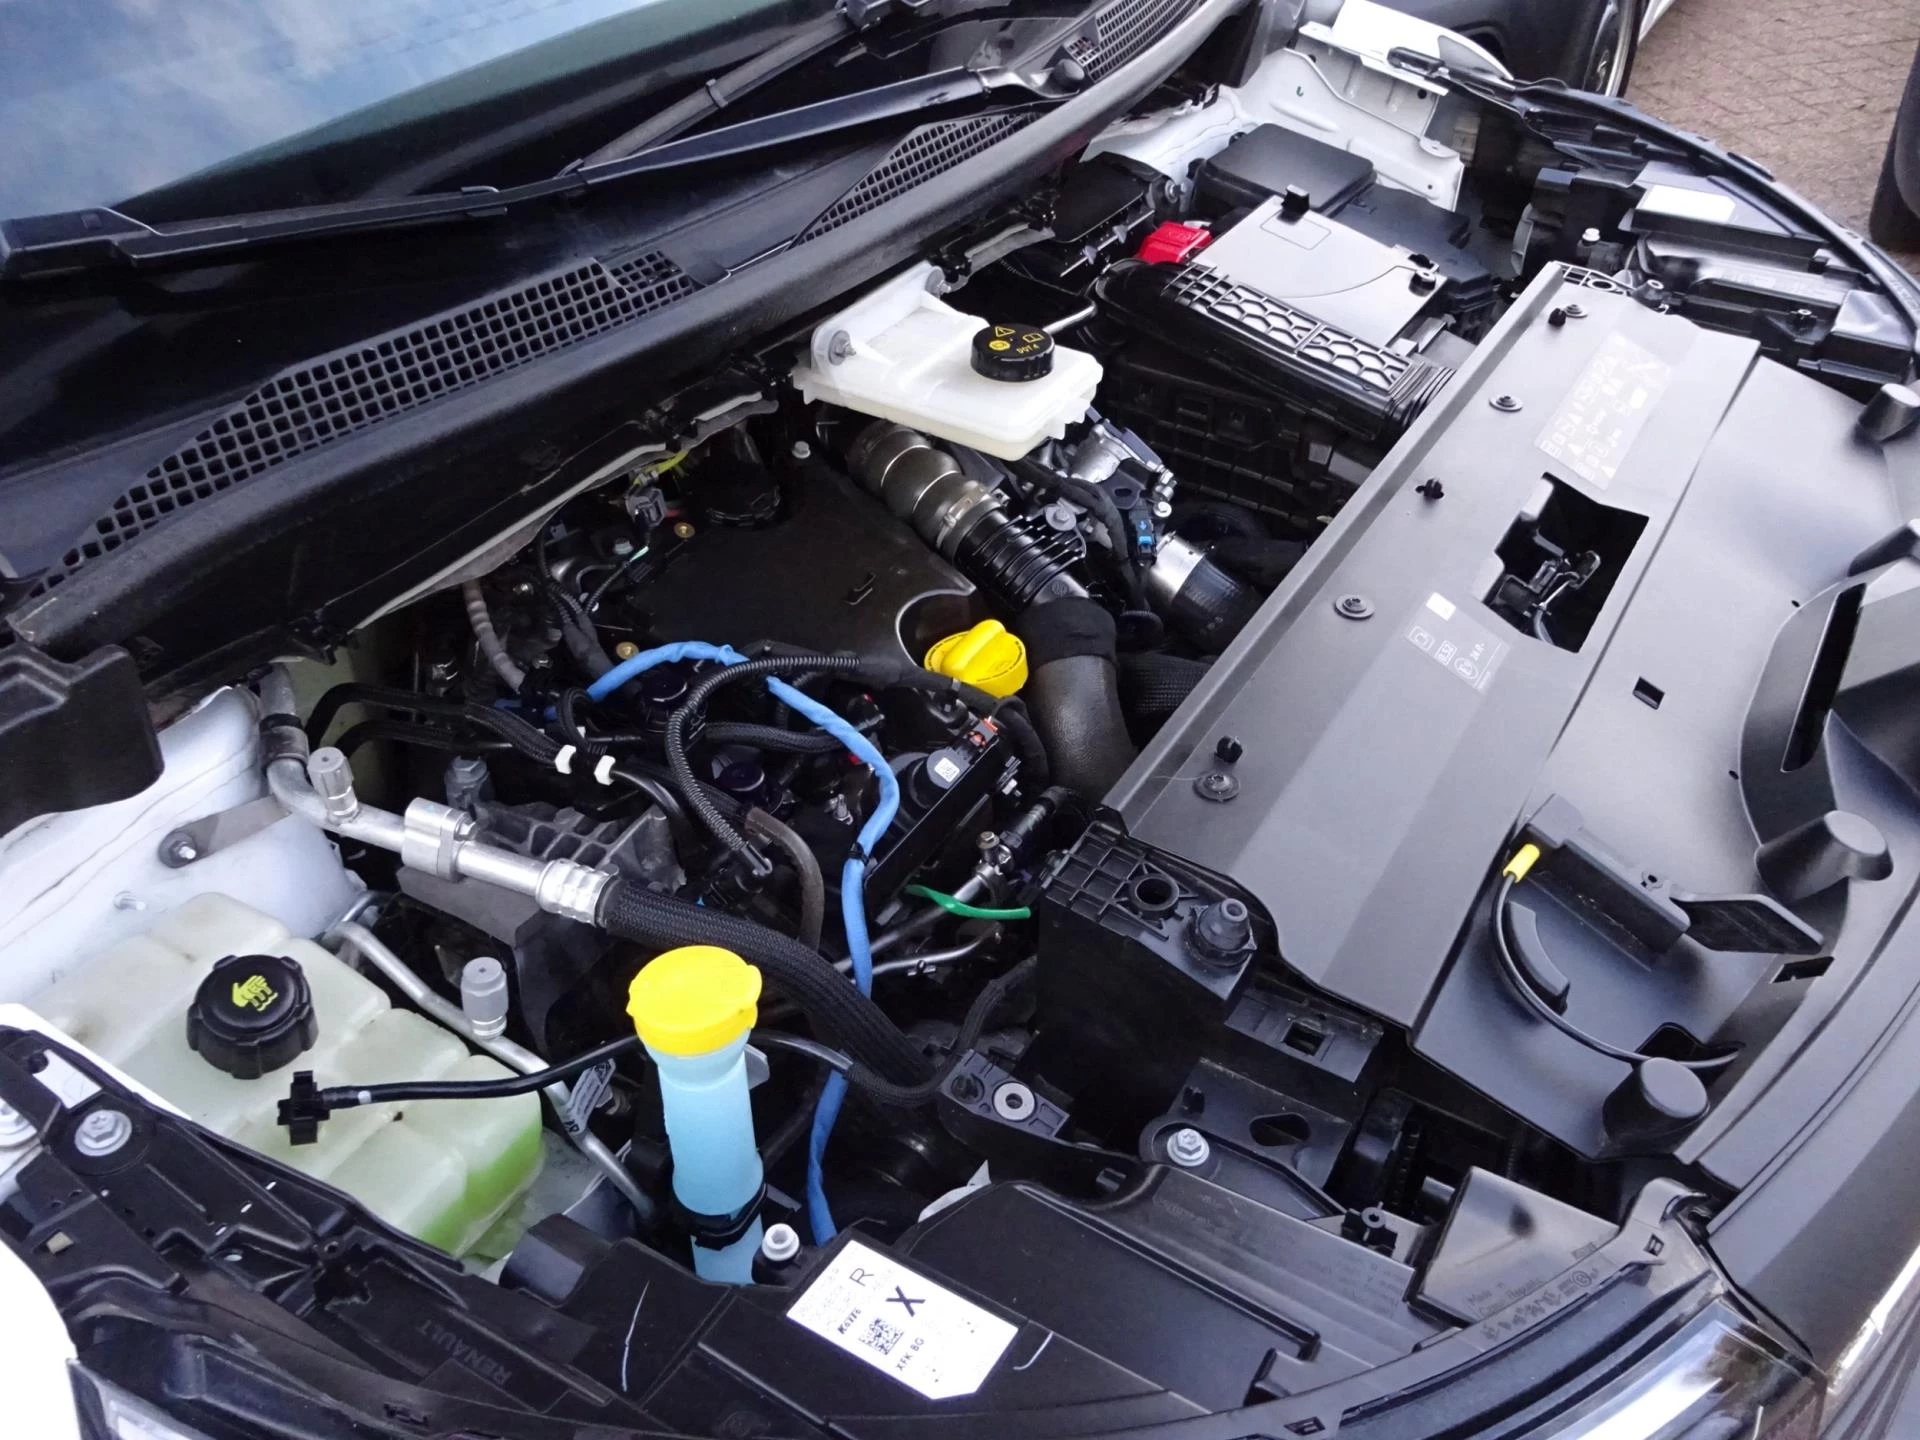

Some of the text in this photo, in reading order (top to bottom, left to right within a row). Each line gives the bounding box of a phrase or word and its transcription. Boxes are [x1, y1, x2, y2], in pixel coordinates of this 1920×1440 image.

[849, 1267, 874, 1286] R
[885, 1285, 926, 1318] X
[416, 1320, 512, 1385] RENAULT
